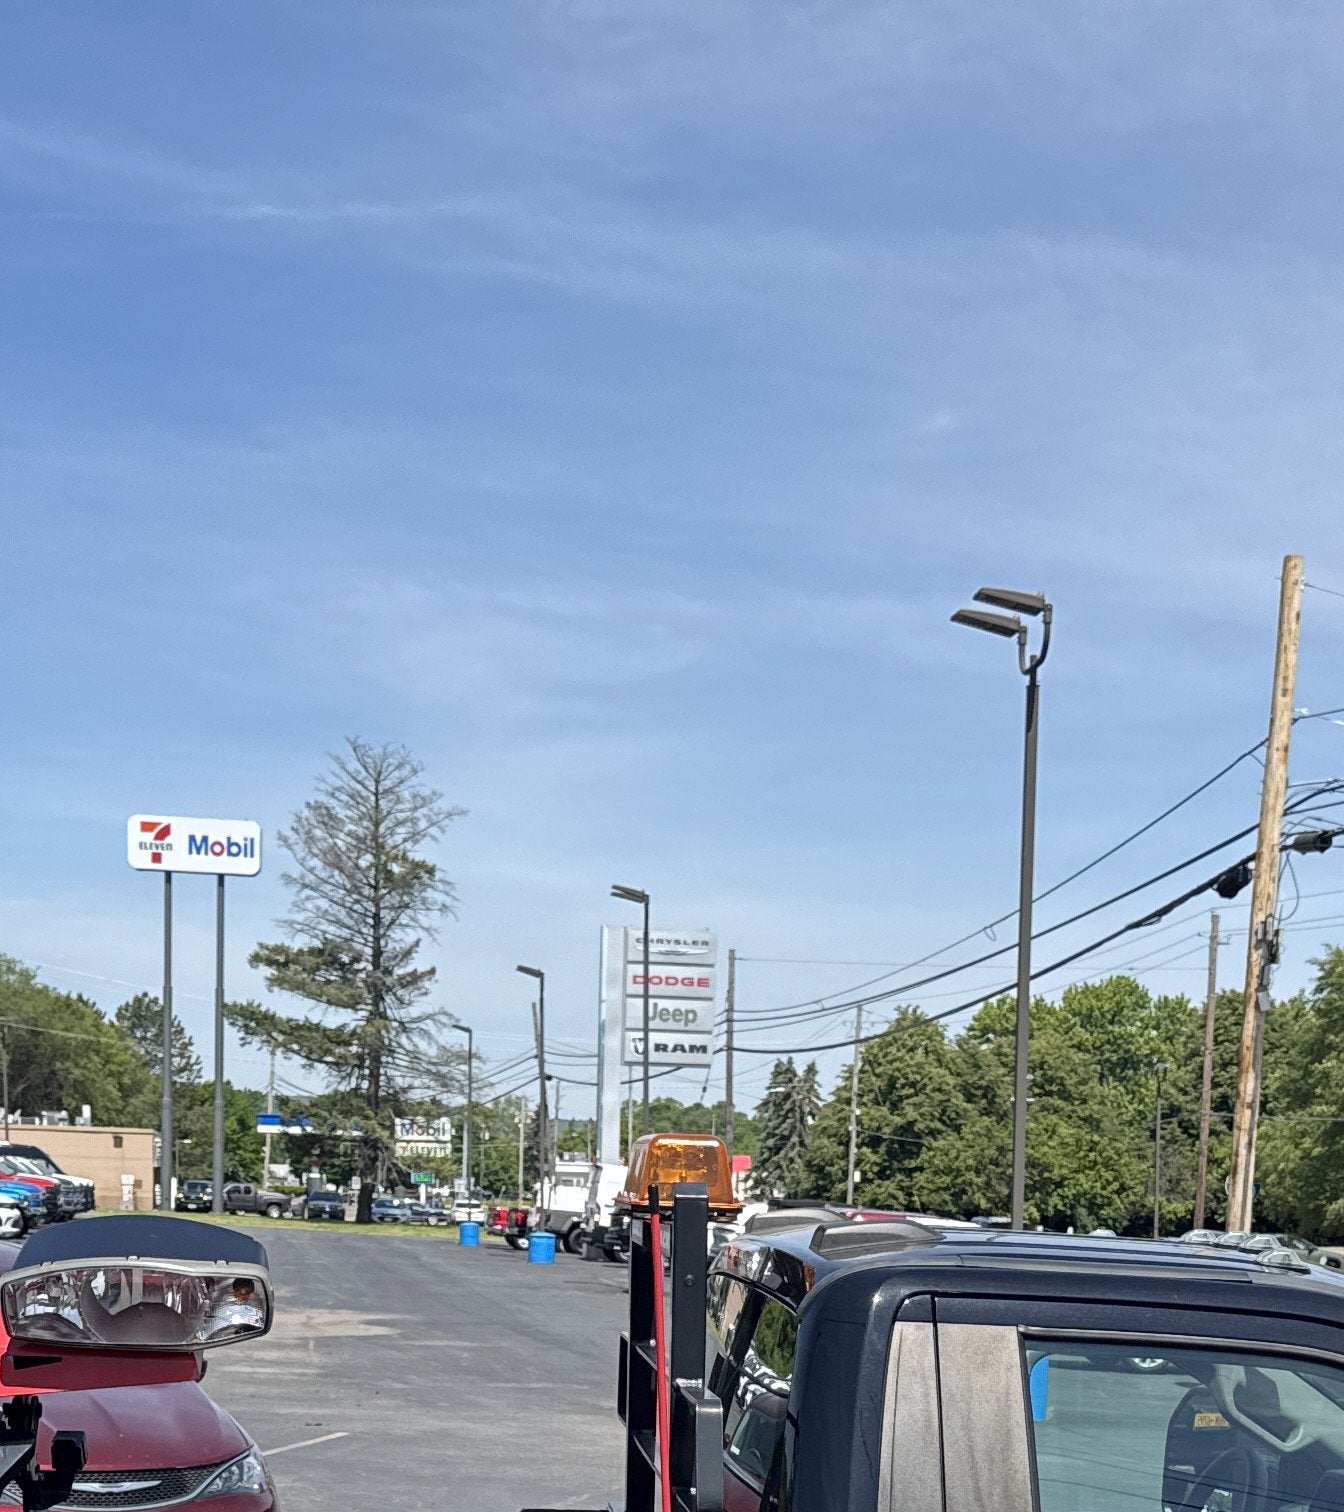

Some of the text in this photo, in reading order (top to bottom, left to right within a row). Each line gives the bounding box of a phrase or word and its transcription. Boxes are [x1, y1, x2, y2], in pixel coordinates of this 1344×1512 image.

[188, 834, 255, 858] Mobil
[632, 975, 711, 988] DODGE
[647, 1002, 698, 1027] Jeep
[653, 1042, 708, 1054] RAM
